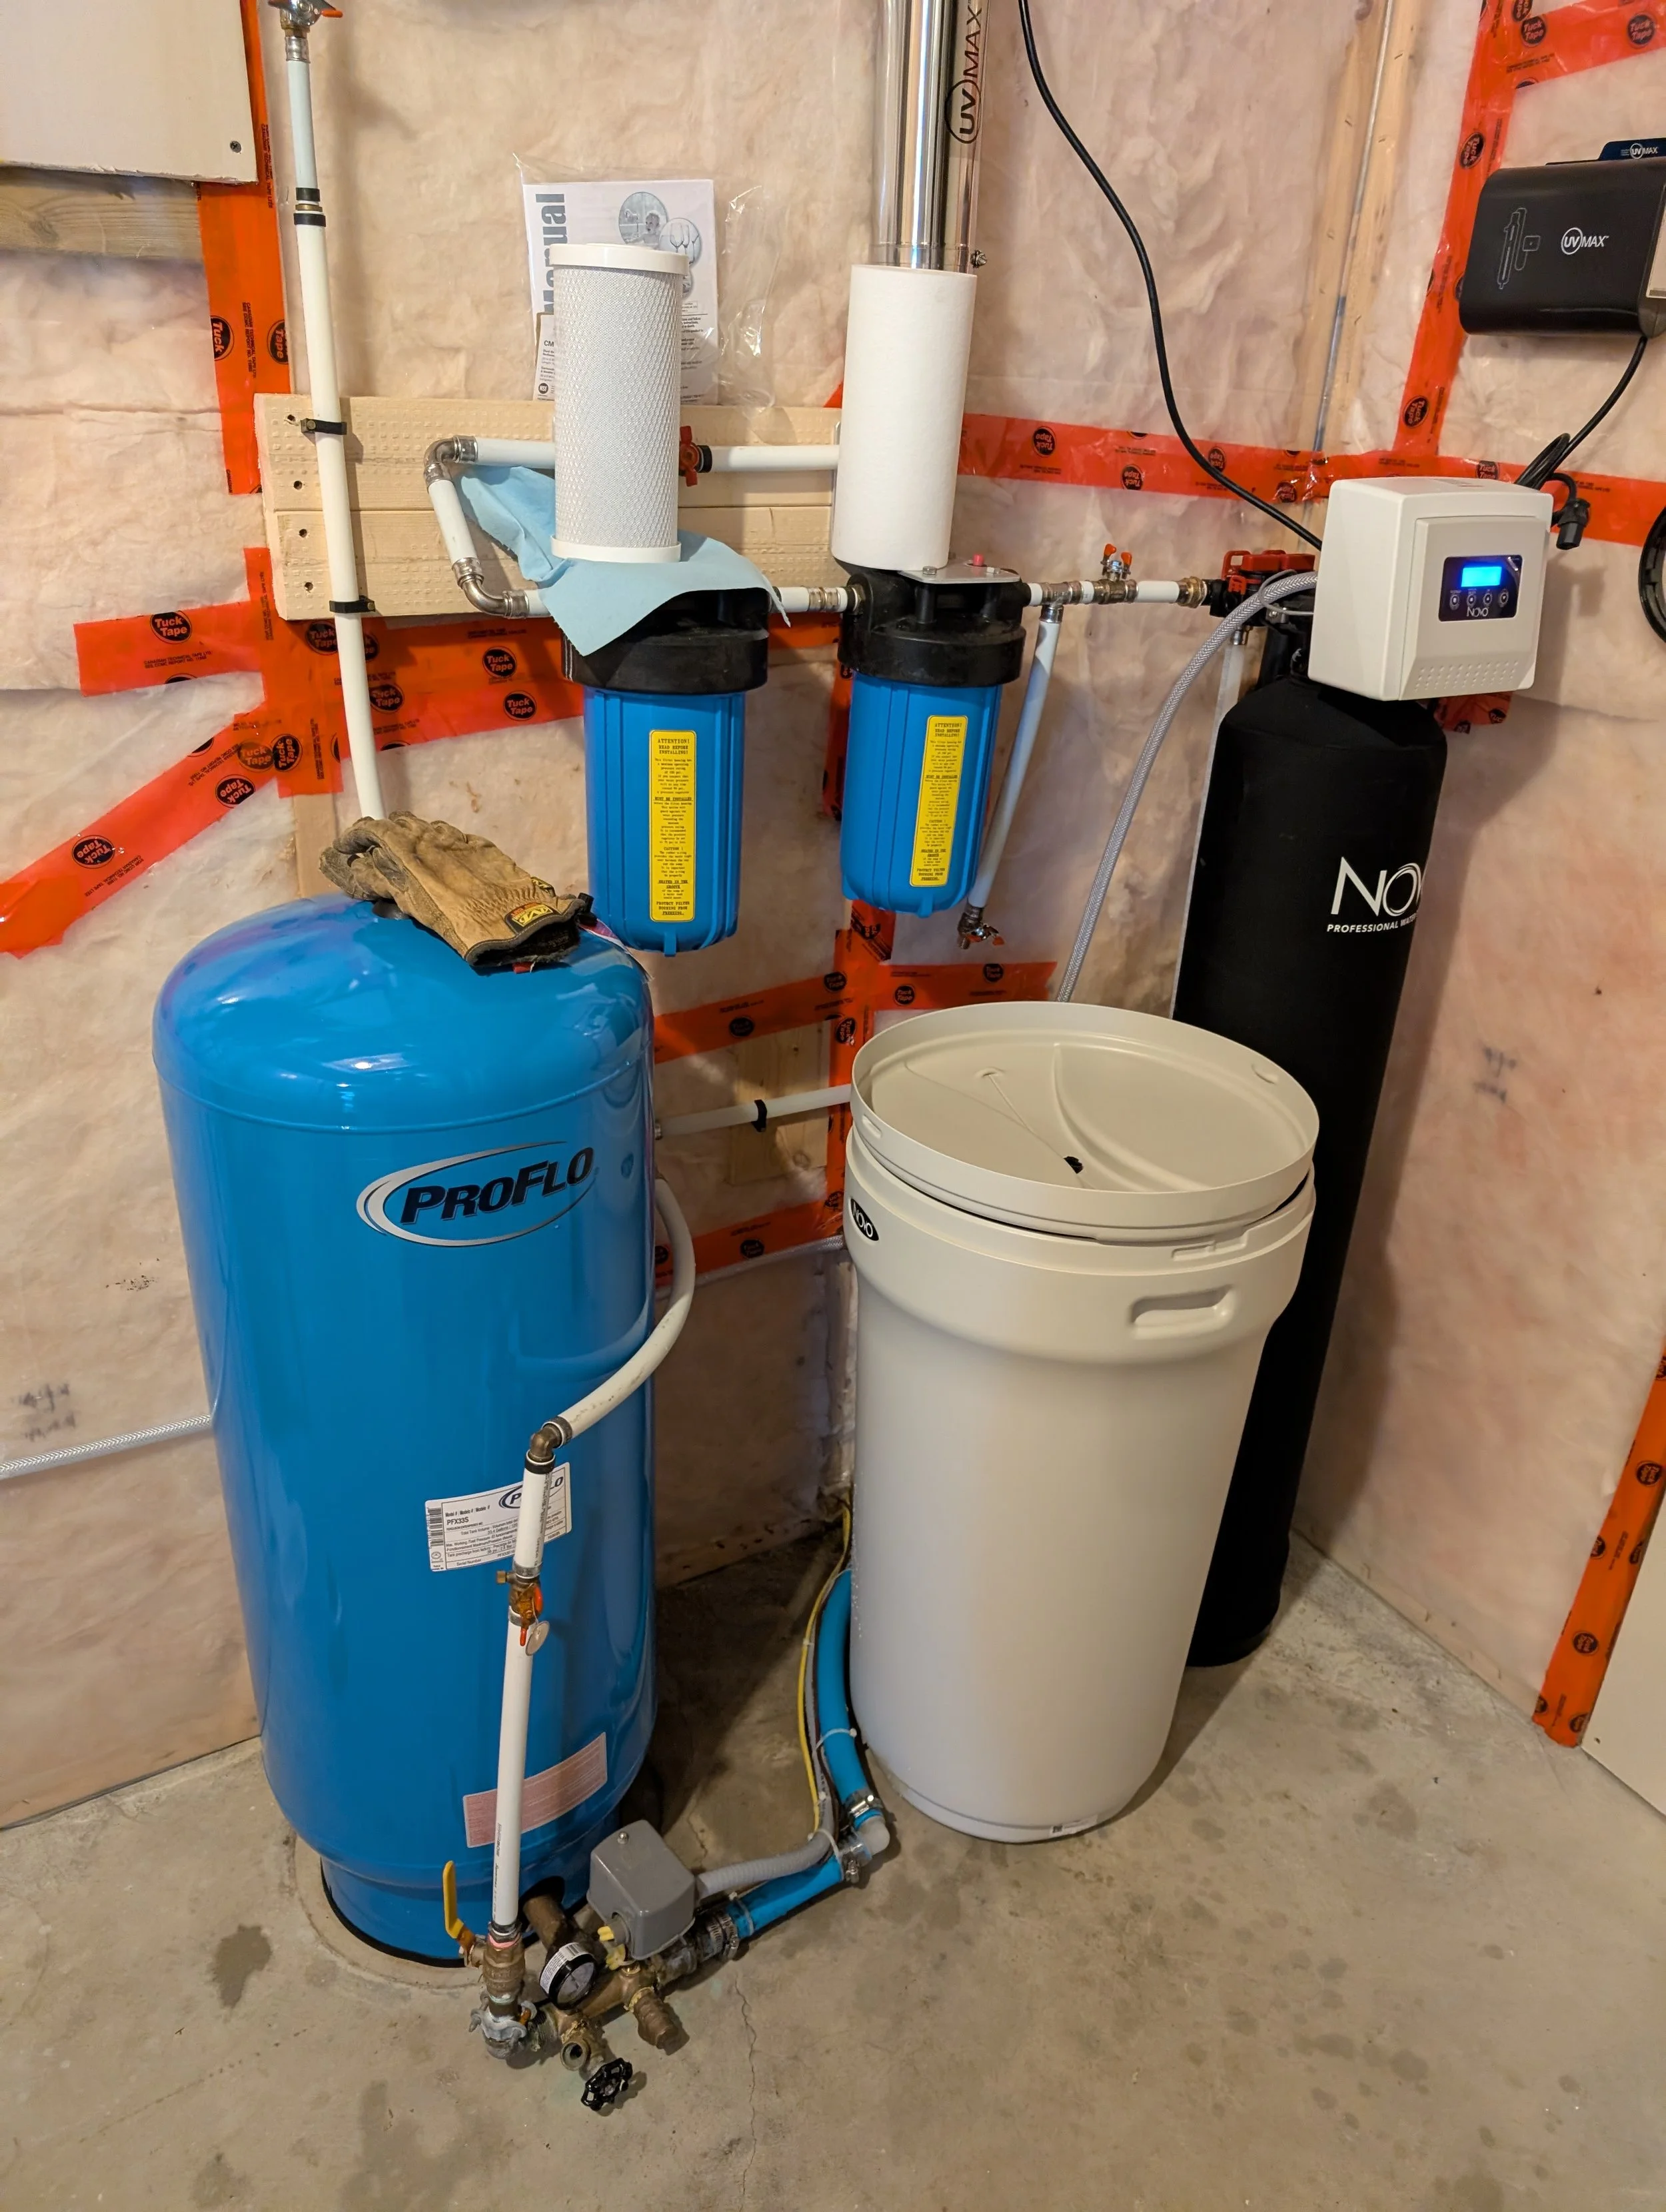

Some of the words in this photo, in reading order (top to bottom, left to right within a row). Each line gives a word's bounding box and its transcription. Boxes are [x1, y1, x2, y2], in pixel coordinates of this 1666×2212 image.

[1524, 21, 1542, 31] Tuck
[1631, 19, 1651, 29] Tuck
[1525, 29, 1543, 40] Tape
[1632, 29, 1652, 41] Tape
[213, 322, 224, 352] Tuck
[275, 328, 285, 358] Tape
[1408, 402, 1418, 424] Tape
[1414, 400, 1425, 422] Tuck
[1036, 433, 1052, 442] Tape
[1036, 441, 1052, 451] Tuck
[154, 616, 183, 628] Tuck
[160, 626, 187, 637] Tape
[486, 654, 510, 664] Tuck
[490, 663, 512, 672] Tape
[376, 697, 400, 707] Tape
[507, 698, 529, 708] Tuck
[510, 706, 532, 716] Tape
[241, 746, 266, 756] Tuck
[277, 741, 287, 768] Tuck
[285, 738, 295, 763] Tape
[245, 756, 271, 766] Tape
[220, 780, 244, 797] Tape
[227, 784, 252, 802] Tuck
[77, 840, 102, 857] Tape
[85, 845, 111, 863] Tuck
[1327, 921, 1399, 933] PROFESSIONAL
[401, 1147, 594, 1225] PROFLO
[854, 1201, 873, 1237] NOVO
[447, 1516, 469, 1526] PFX33S
